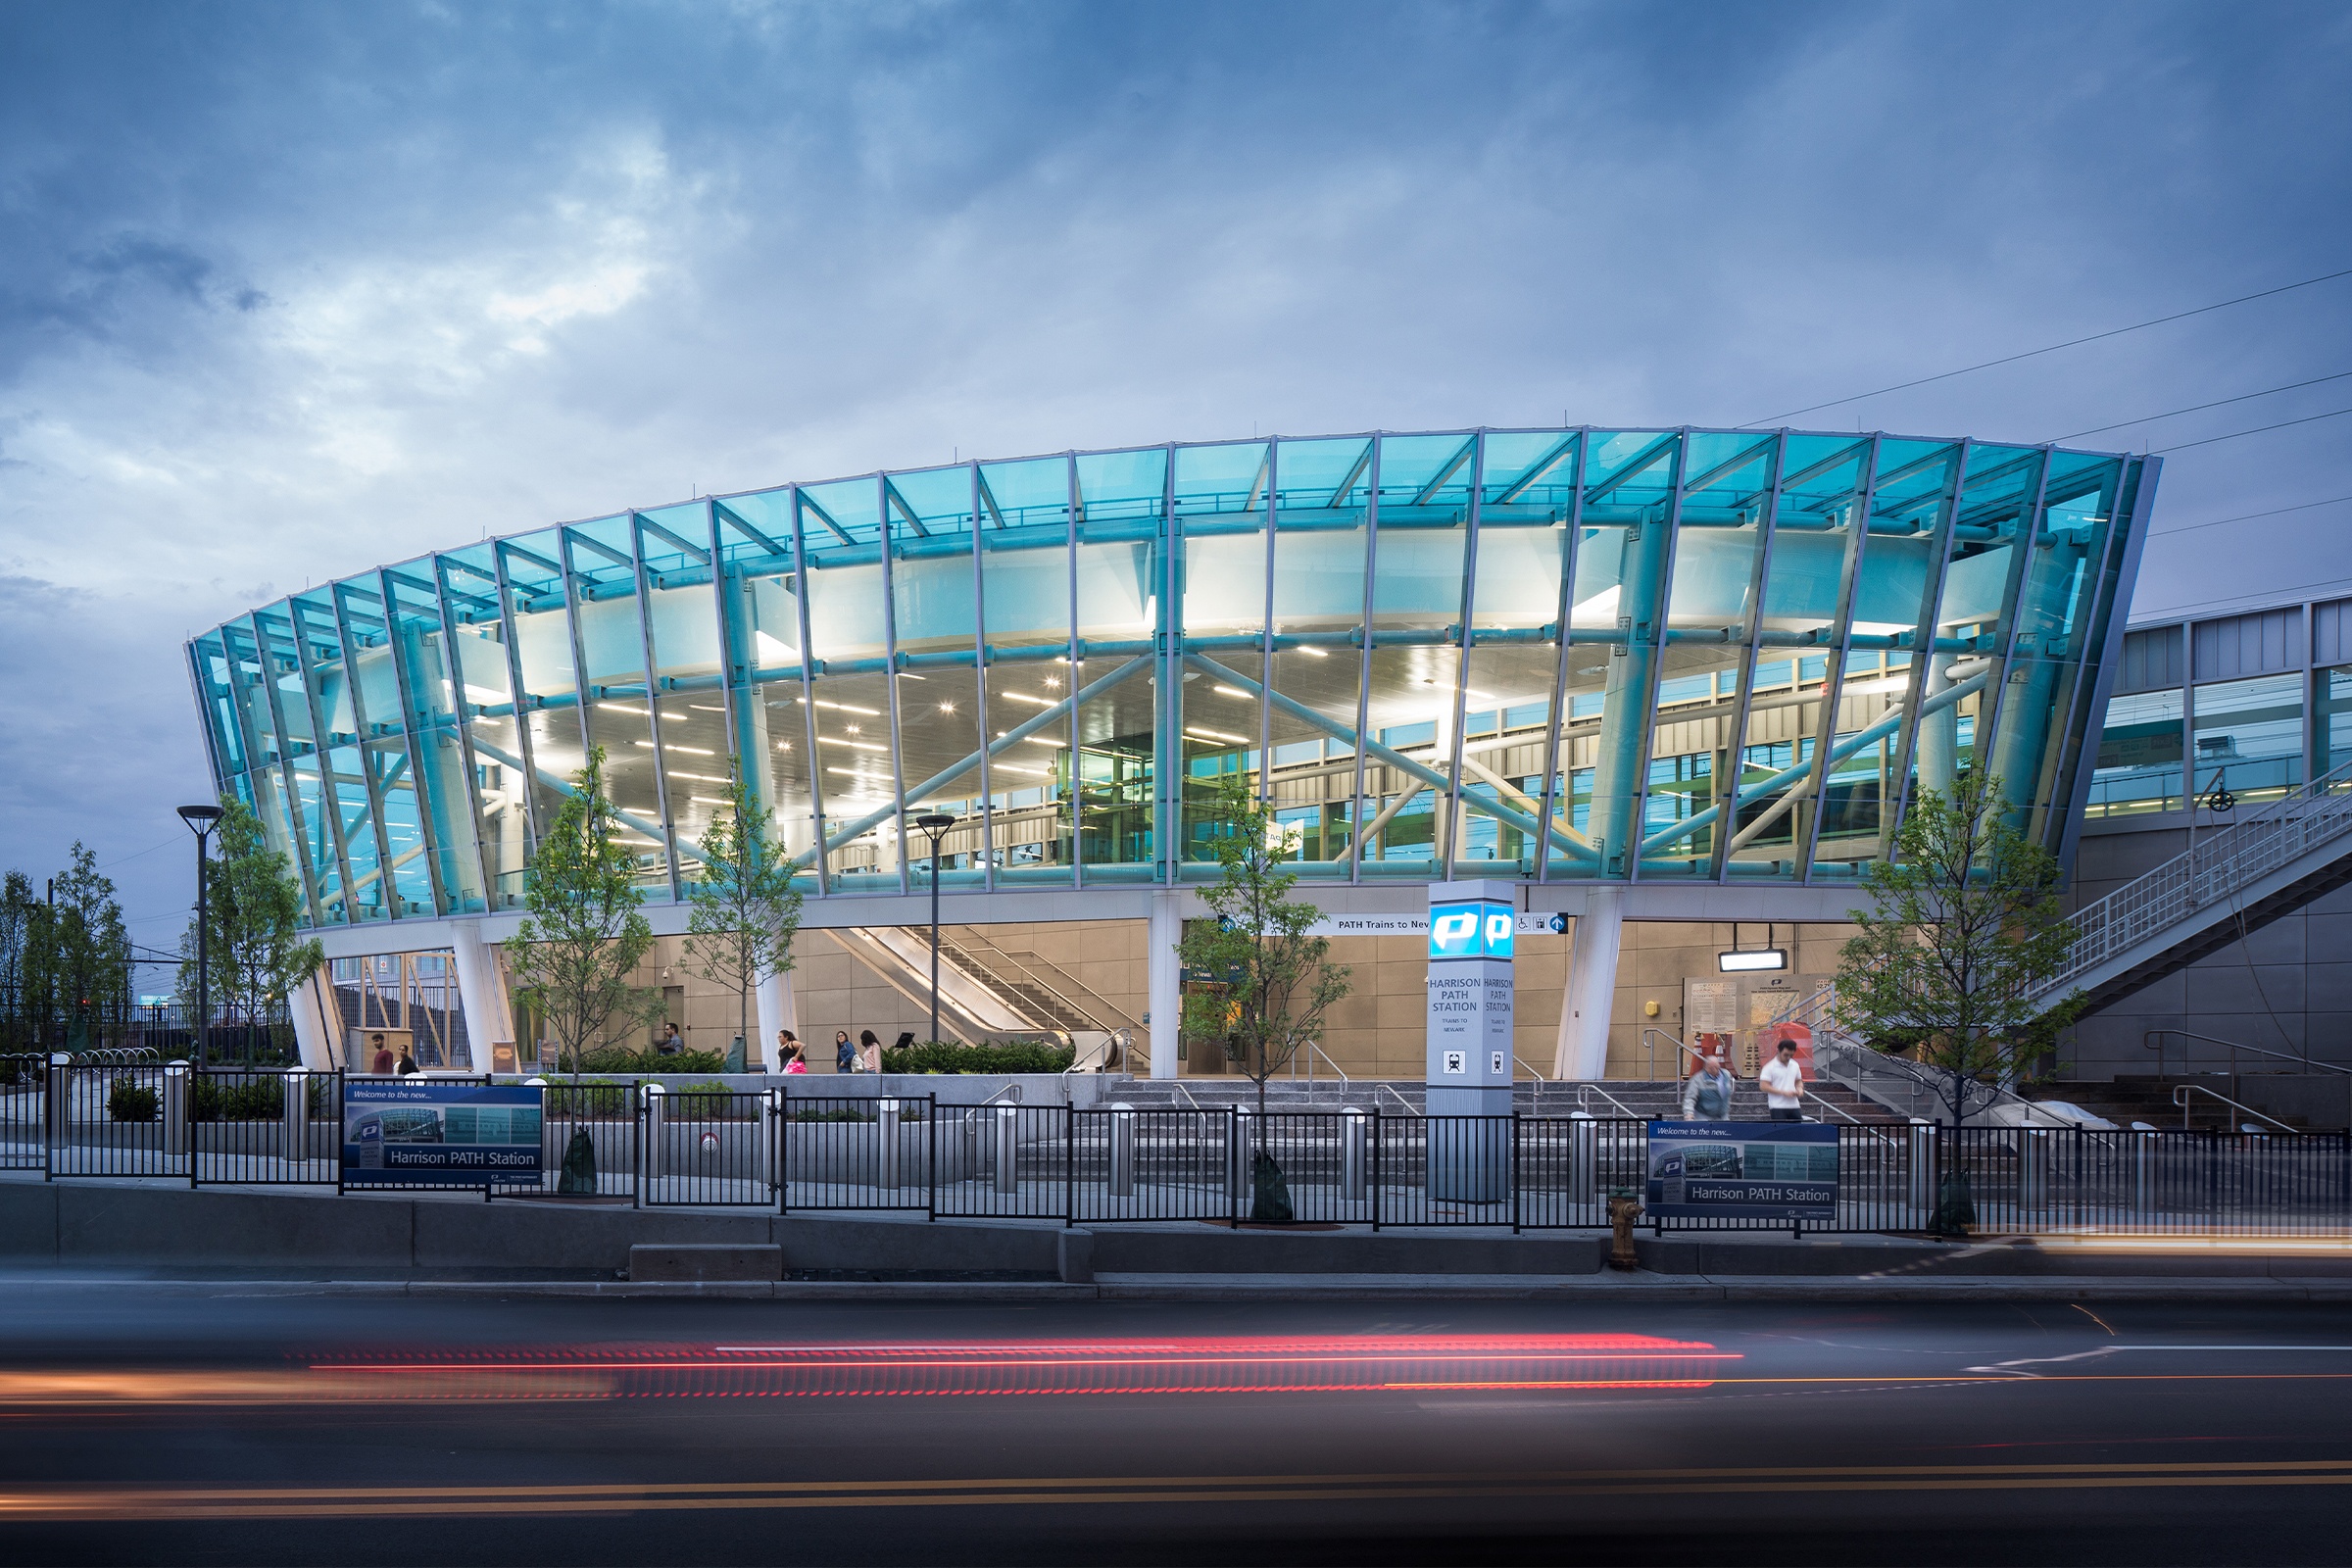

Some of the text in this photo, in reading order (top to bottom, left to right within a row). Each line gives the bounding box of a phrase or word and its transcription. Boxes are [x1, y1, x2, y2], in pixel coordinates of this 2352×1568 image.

[1339, 920, 1363, 929] PATH
[1366, 920, 1395, 929] Trains
[1397, 920, 1408, 929] to
[1429, 978, 1481, 989] HARRISON
[1484, 978, 1513, 989] HARRISON
[1442, 990, 1469, 1000] PATH
[1491, 990, 1506, 1000] PATH
[1433, 1002, 1477, 1012] STATION
[1486, 1002, 1511, 1012] STATION
[1657, 1127, 1689, 1136] Welcome
[391, 1151, 446, 1164] Harrison
[451, 1152, 484, 1165] PATH
[489, 1152, 535, 1165] Station
[1692, 1187, 1830, 1201] Harrison PATH Station
